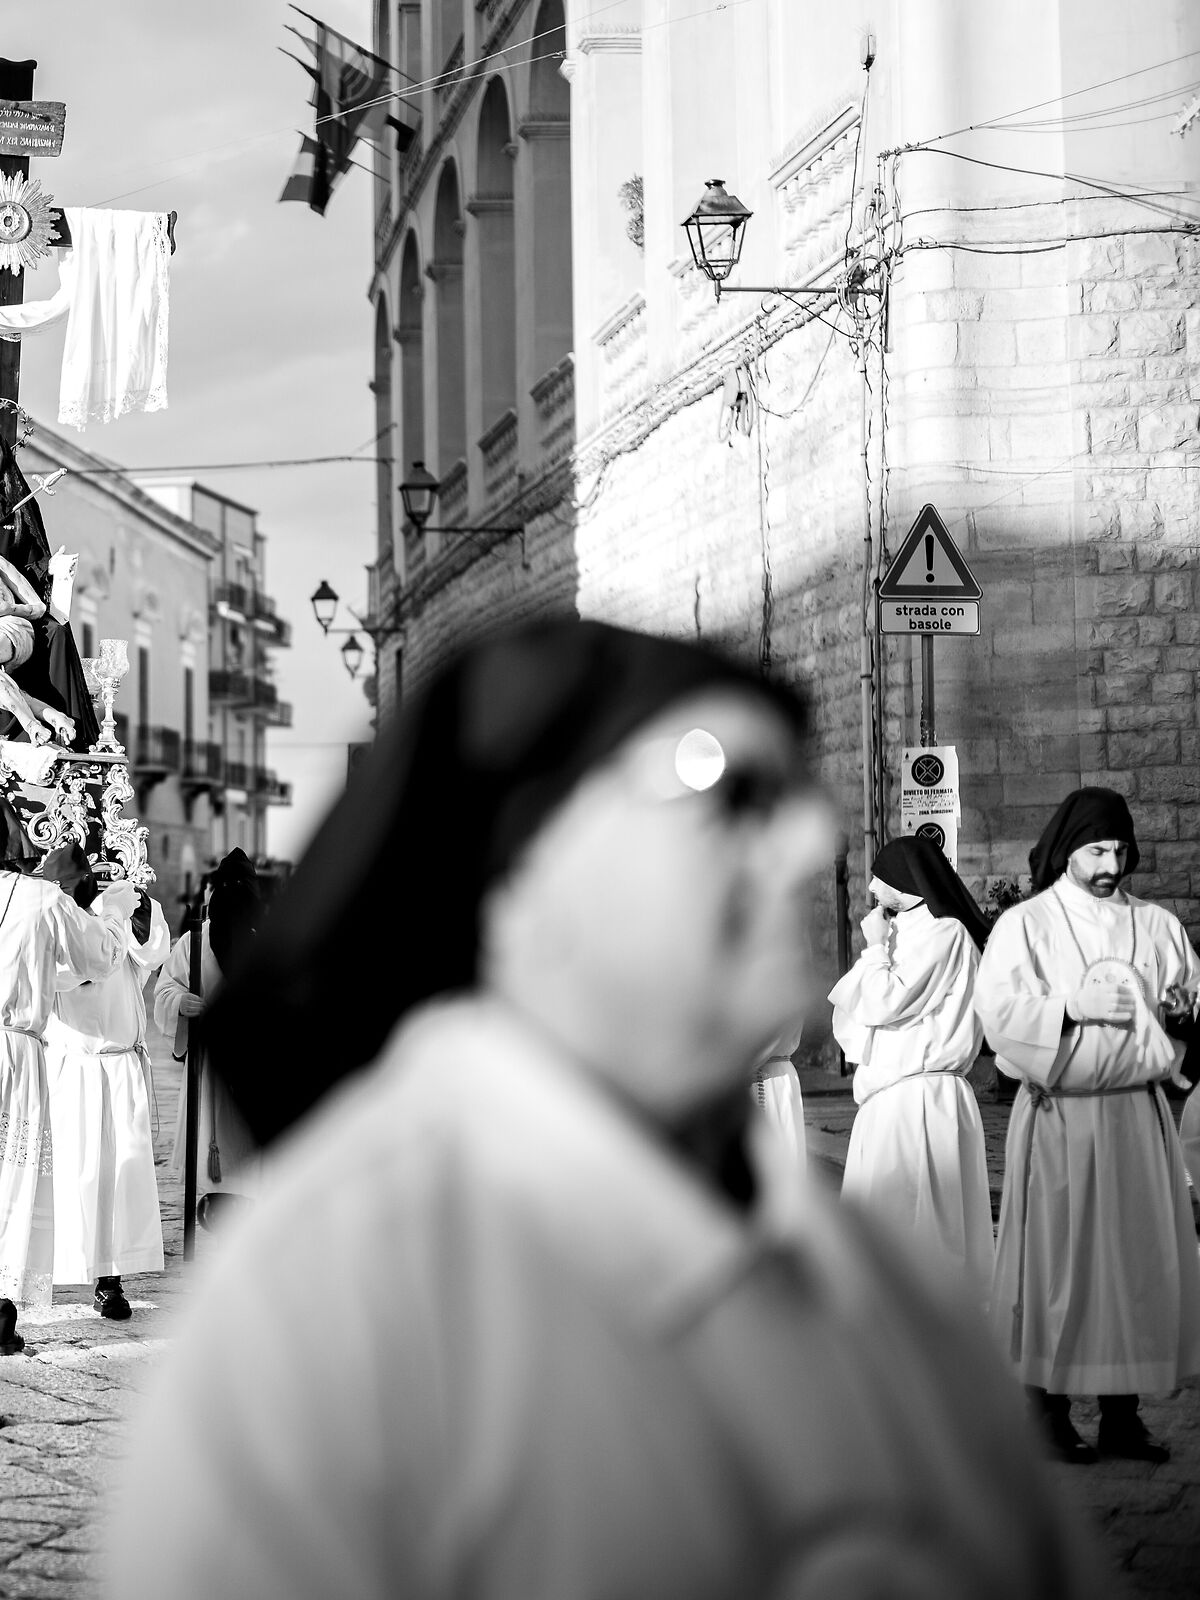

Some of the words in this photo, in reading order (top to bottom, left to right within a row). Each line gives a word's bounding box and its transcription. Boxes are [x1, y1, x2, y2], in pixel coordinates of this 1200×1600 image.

[895, 604, 937, 616] strada
[940, 607, 965, 616] con
[909, 618, 952, 630] basole
